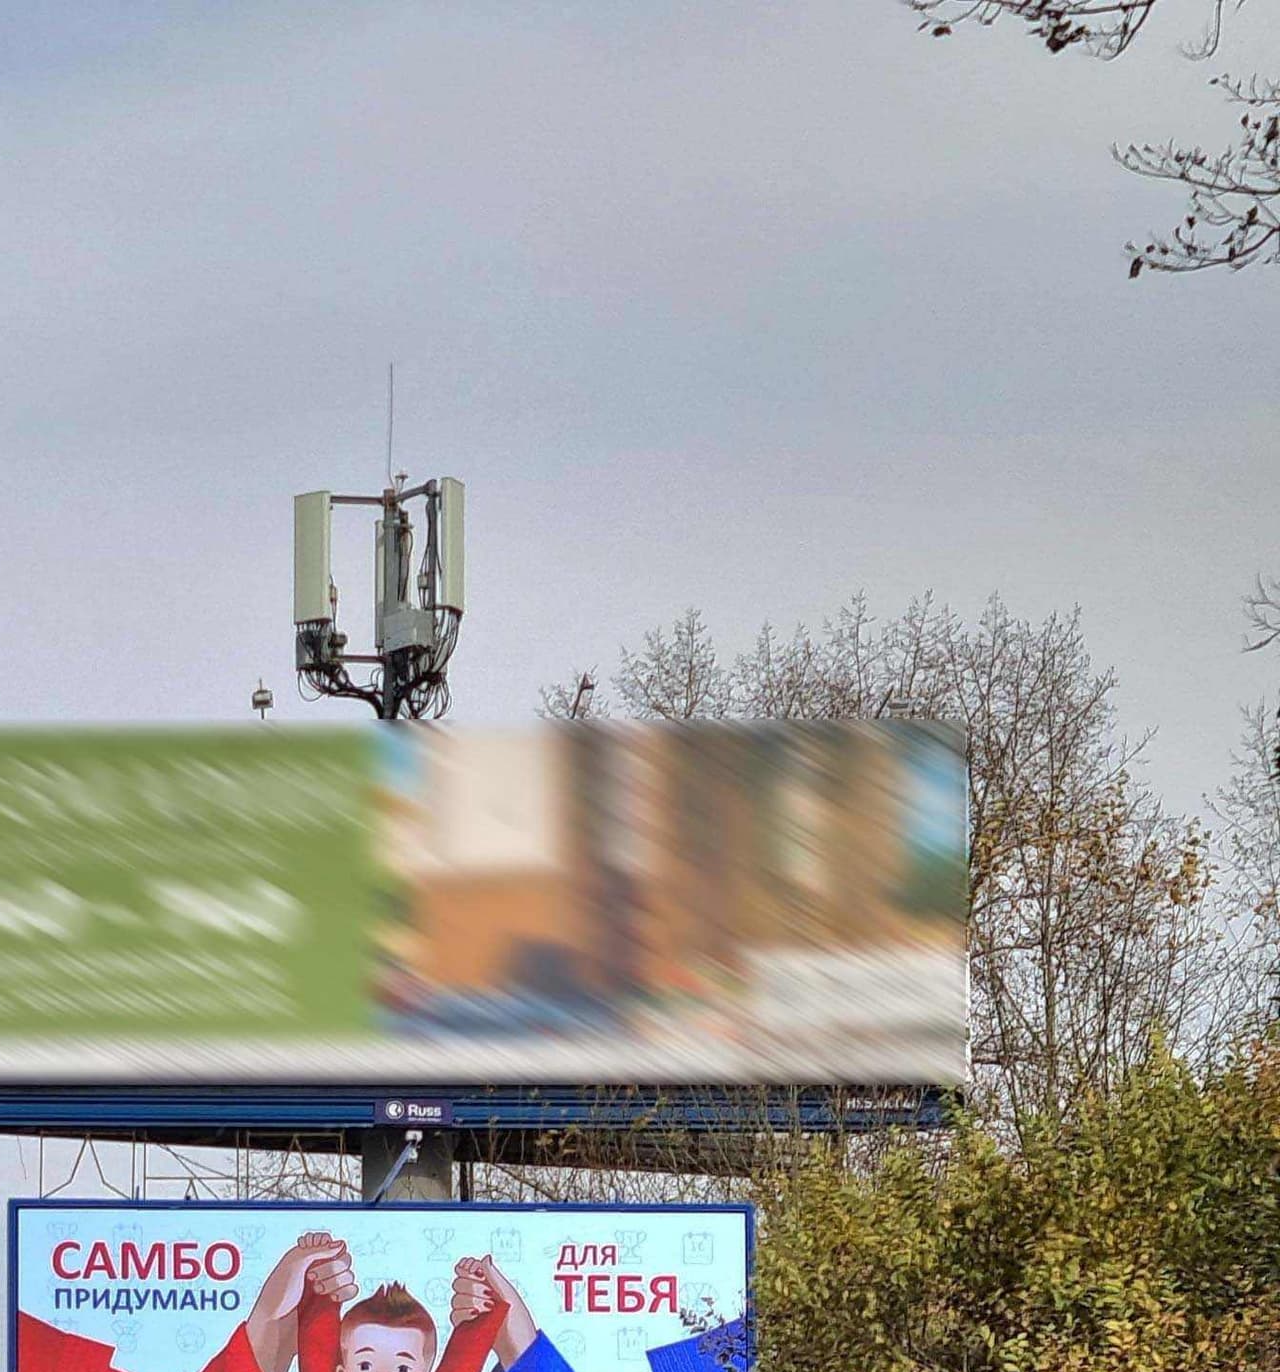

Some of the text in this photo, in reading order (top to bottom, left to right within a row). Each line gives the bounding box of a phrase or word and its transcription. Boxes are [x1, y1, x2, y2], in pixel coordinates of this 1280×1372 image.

[408, 1103, 442, 1118] Russ
[51, 1240, 242, 1282] САМБО
[556, 1244, 617, 1271] ДЛЯ
[54, 1287, 241, 1315] ПРИДУМАНО
[553, 1274, 678, 1314] ТЕБЯ
